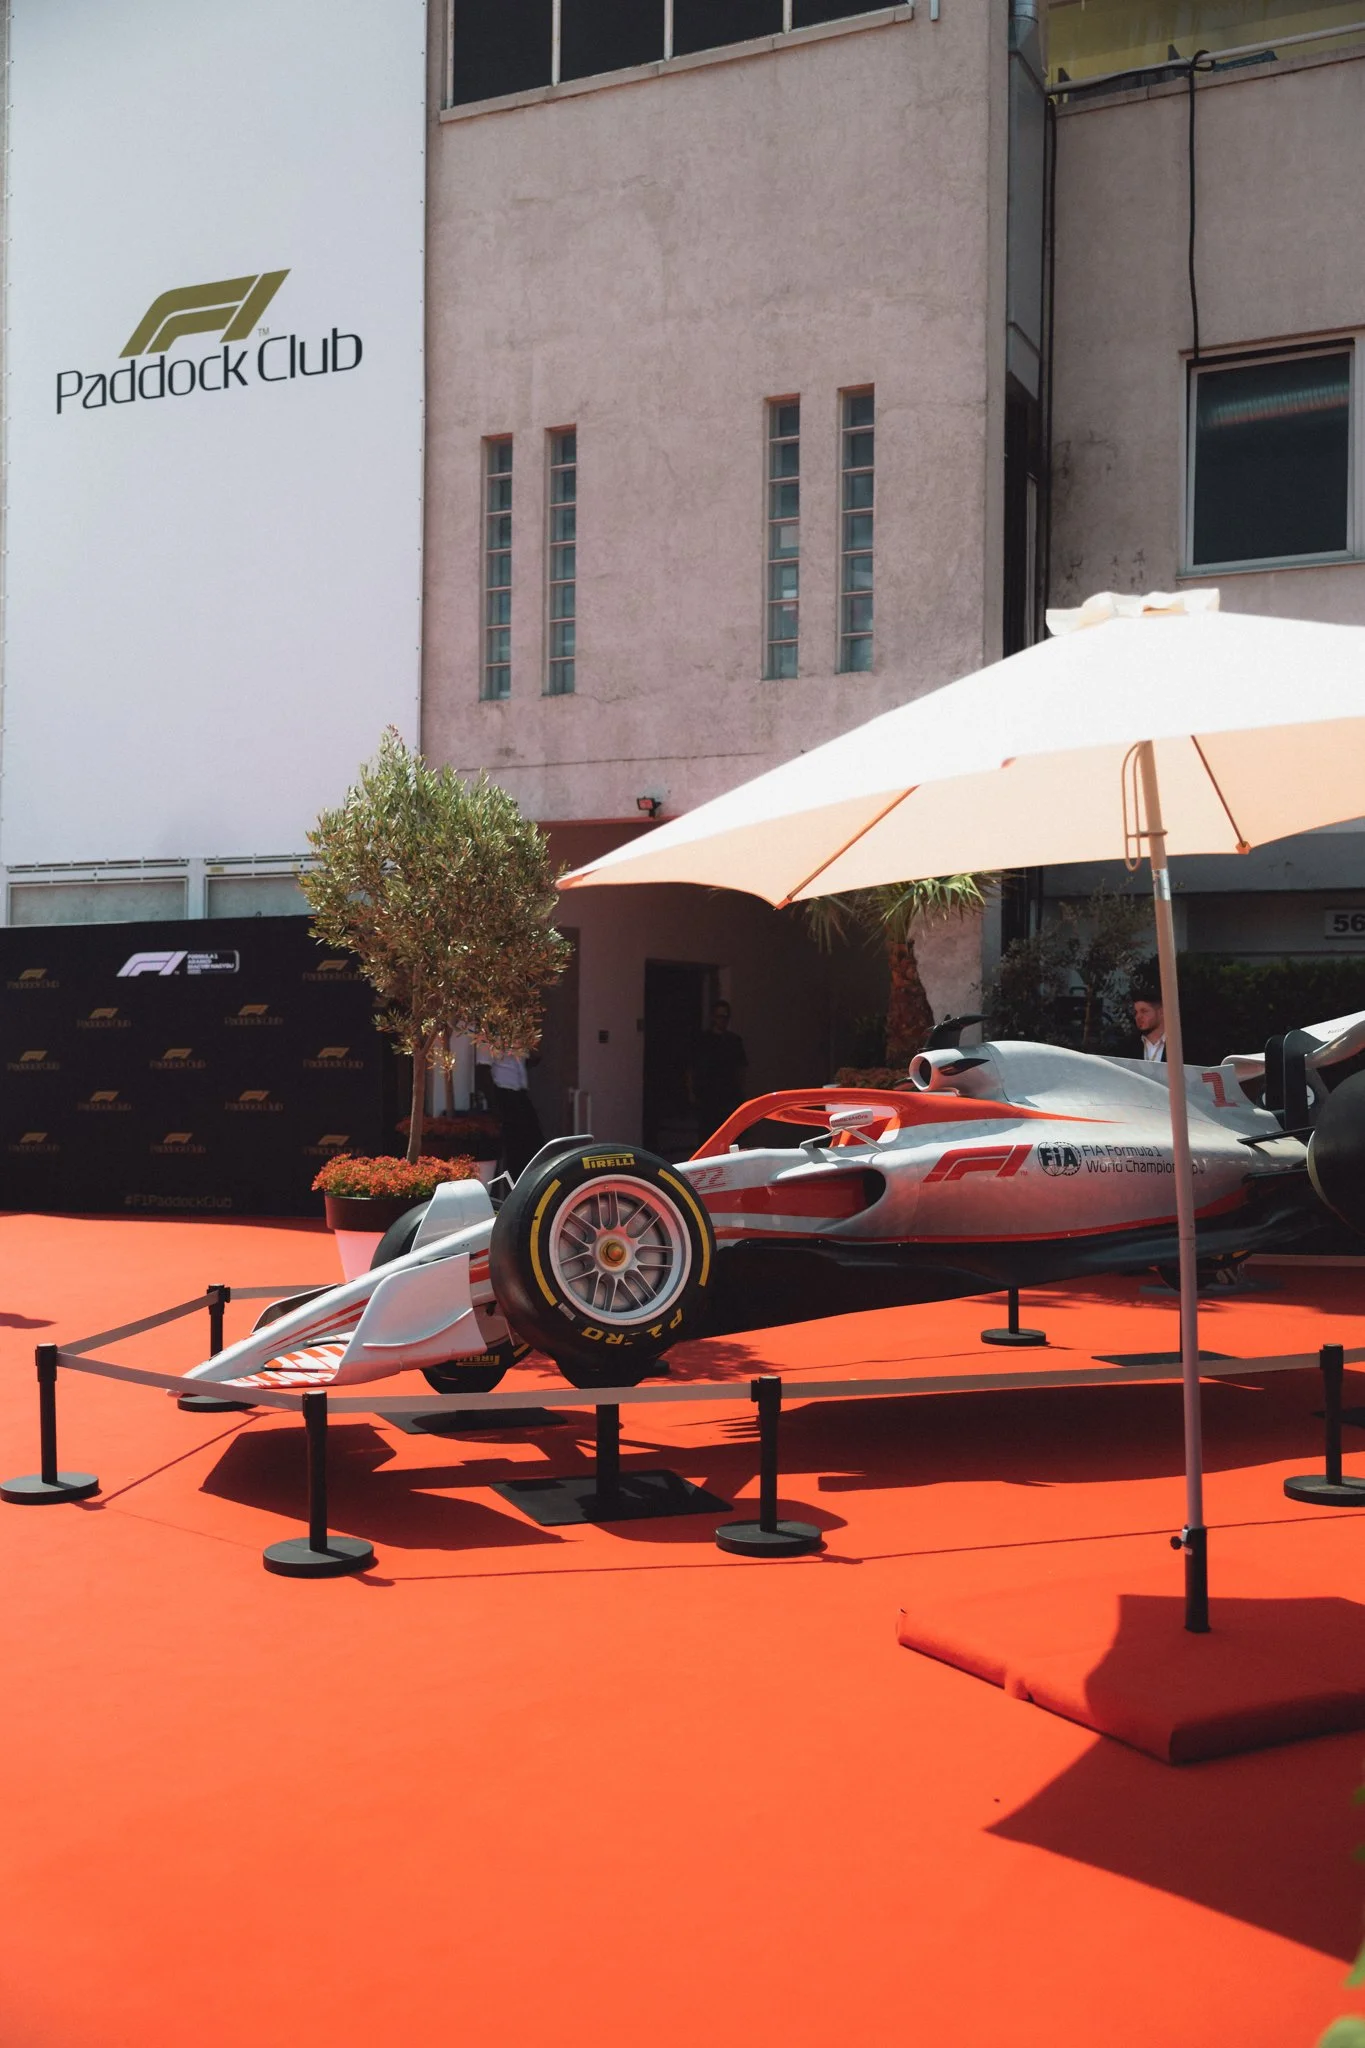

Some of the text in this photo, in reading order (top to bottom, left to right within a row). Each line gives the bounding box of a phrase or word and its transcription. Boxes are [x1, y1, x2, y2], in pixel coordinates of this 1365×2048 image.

[57, 327, 363, 414] Paddock Club
[1333, 913, 1365, 933] 56
[1082, 1145, 1163, 1157] FIA Formula 1
[582, 1153, 635, 1169] PIRELLI
[1086, 1160, 1123, 1173] World
